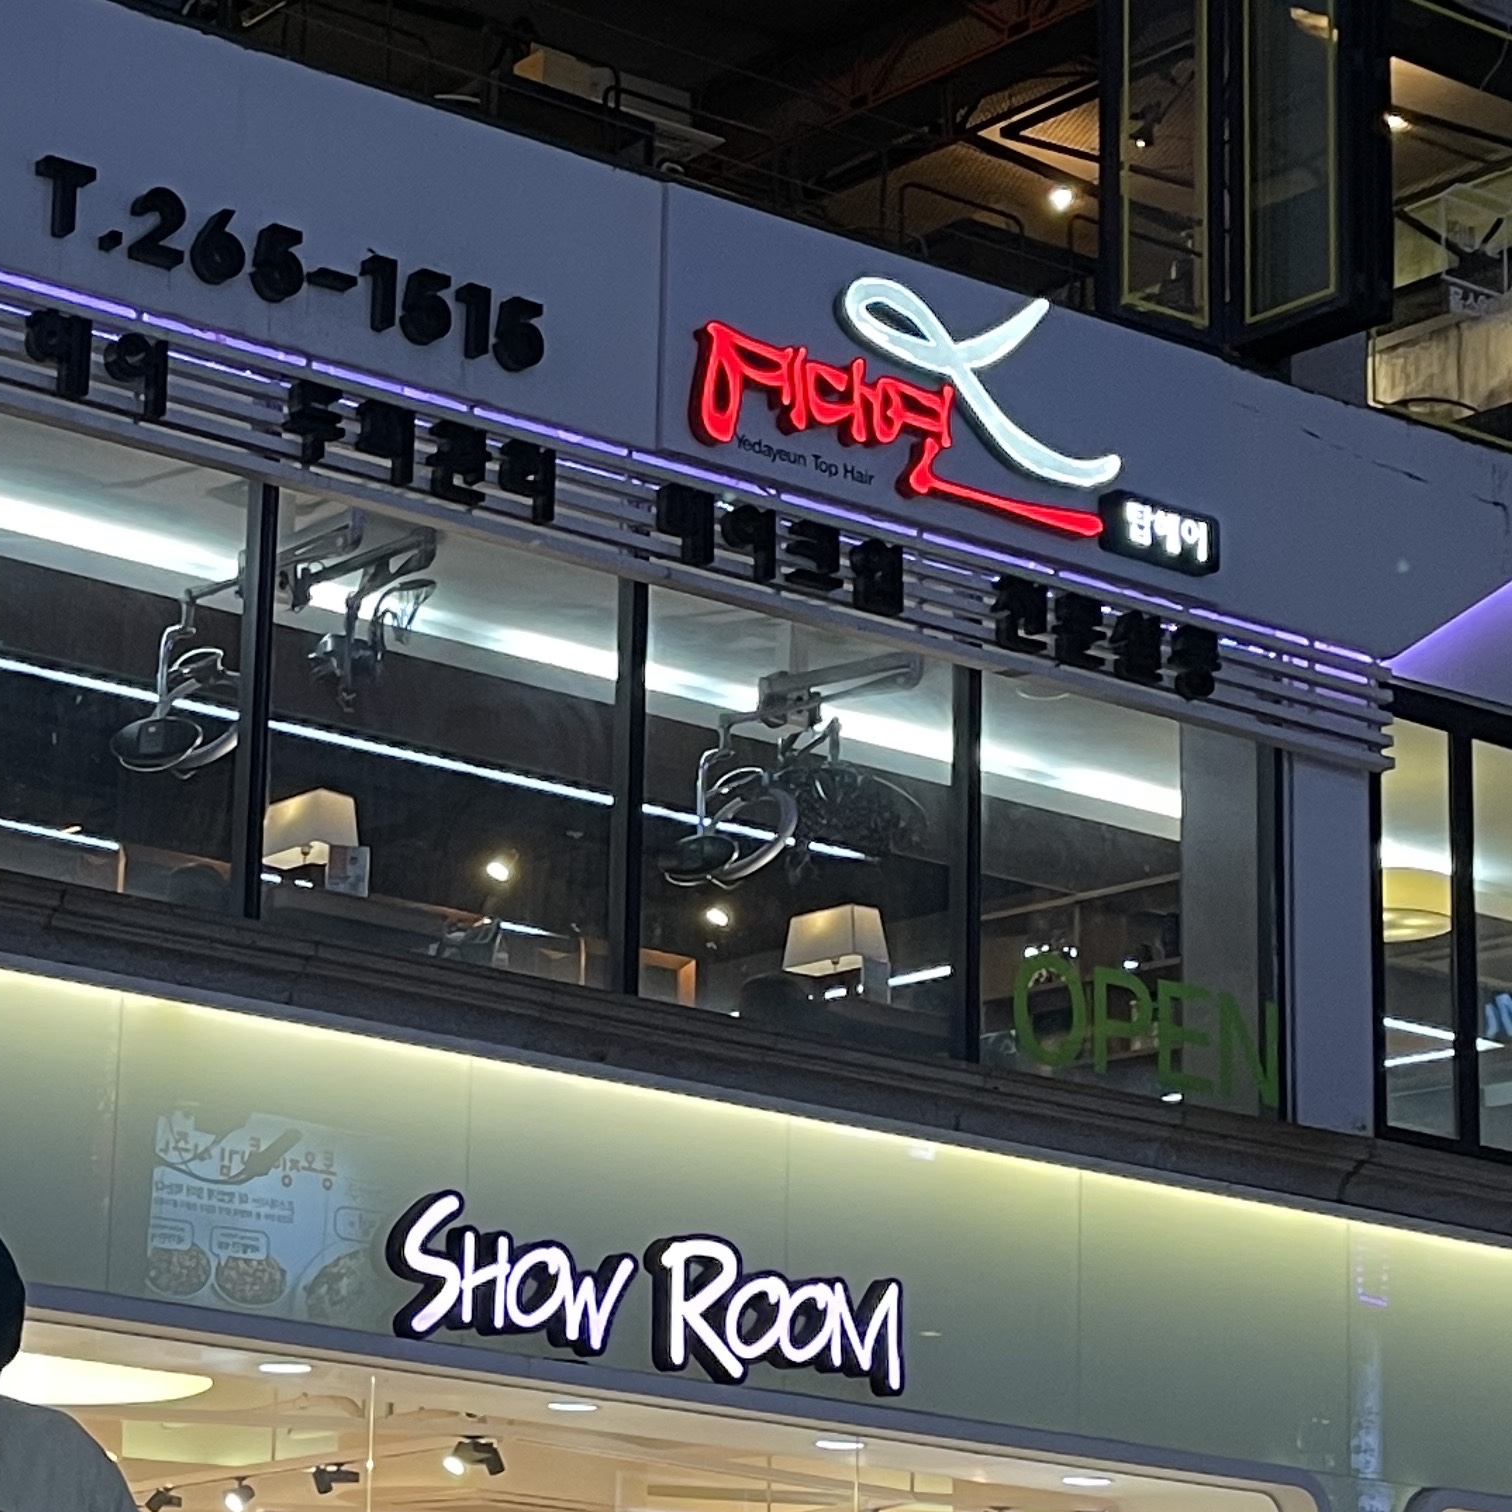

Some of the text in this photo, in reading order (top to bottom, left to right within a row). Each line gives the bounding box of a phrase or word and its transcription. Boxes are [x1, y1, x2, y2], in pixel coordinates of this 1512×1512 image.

[812, 453, 839, 478] Top
[843, 463, 876, 486] Hair
[1013, 950, 1279, 1109] OPEN
[390, 1191, 904, 1395] SHOW ROOM
